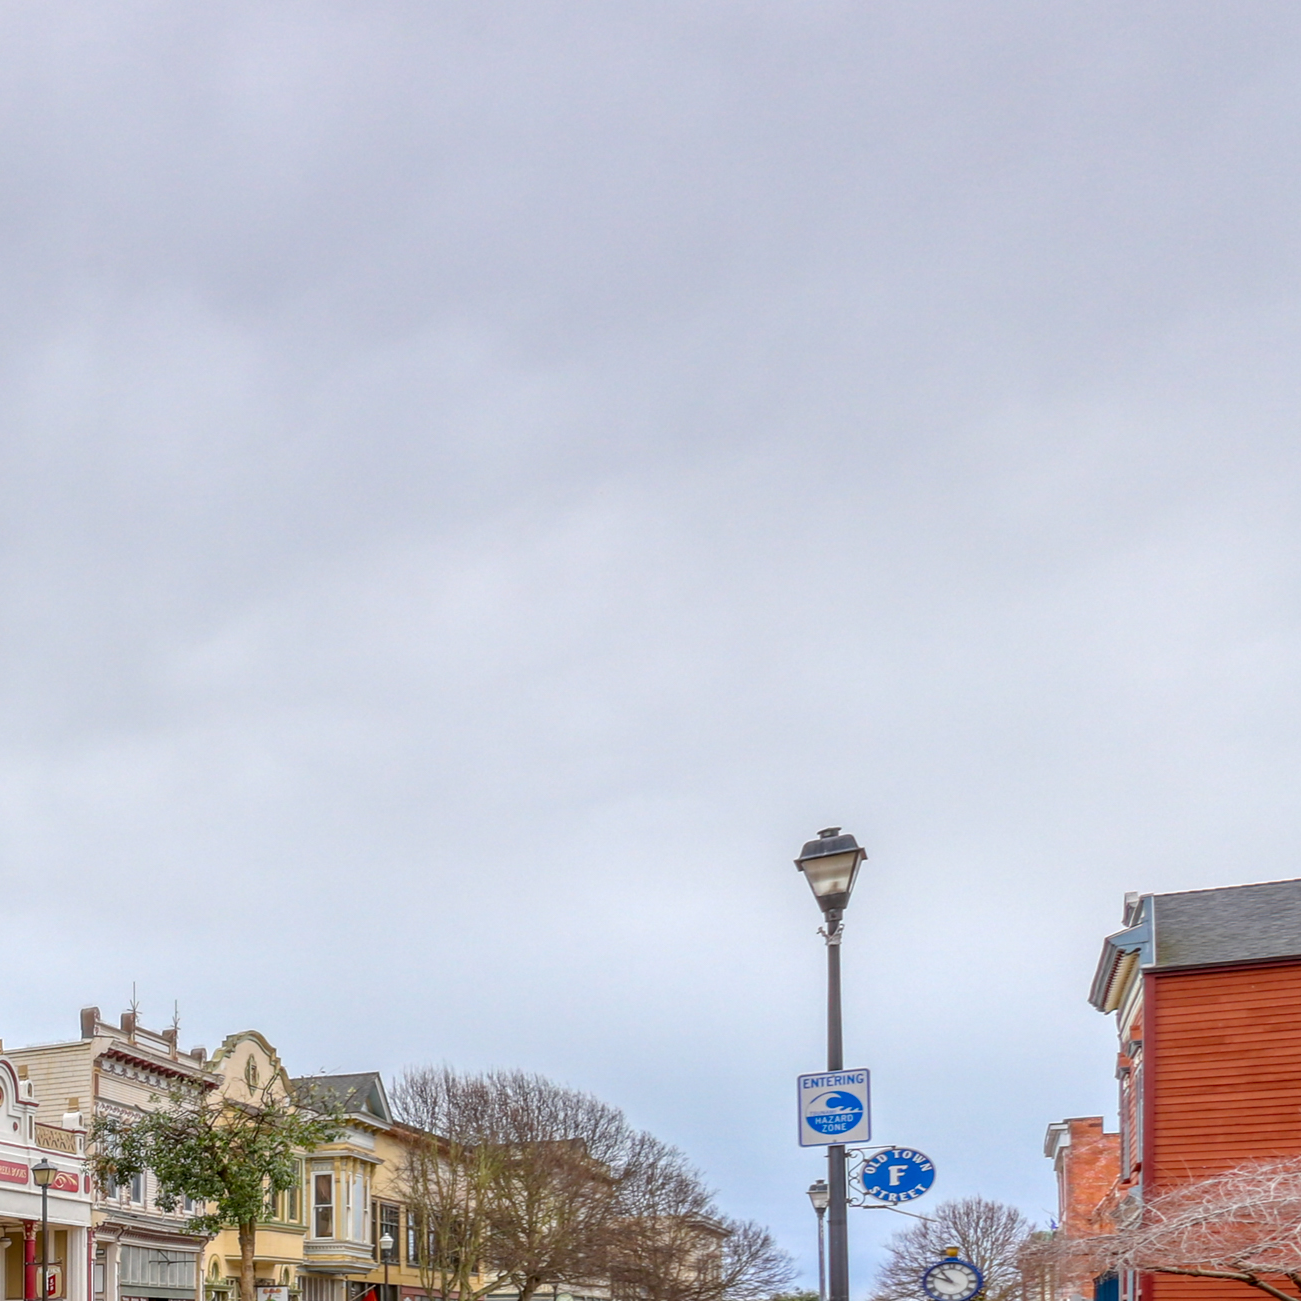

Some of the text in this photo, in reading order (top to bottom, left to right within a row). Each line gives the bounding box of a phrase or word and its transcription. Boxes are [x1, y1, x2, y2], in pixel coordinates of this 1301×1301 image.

[803, 1073, 865, 1089] ENTERING
[814, 1114, 854, 1125] HAZARD
[821, 1122, 847, 1133] ZONE
[864, 1149, 933, 1175] OLD TOWN
[888, 1165, 908, 1186] F
[868, 1183, 927, 1202] STREET
